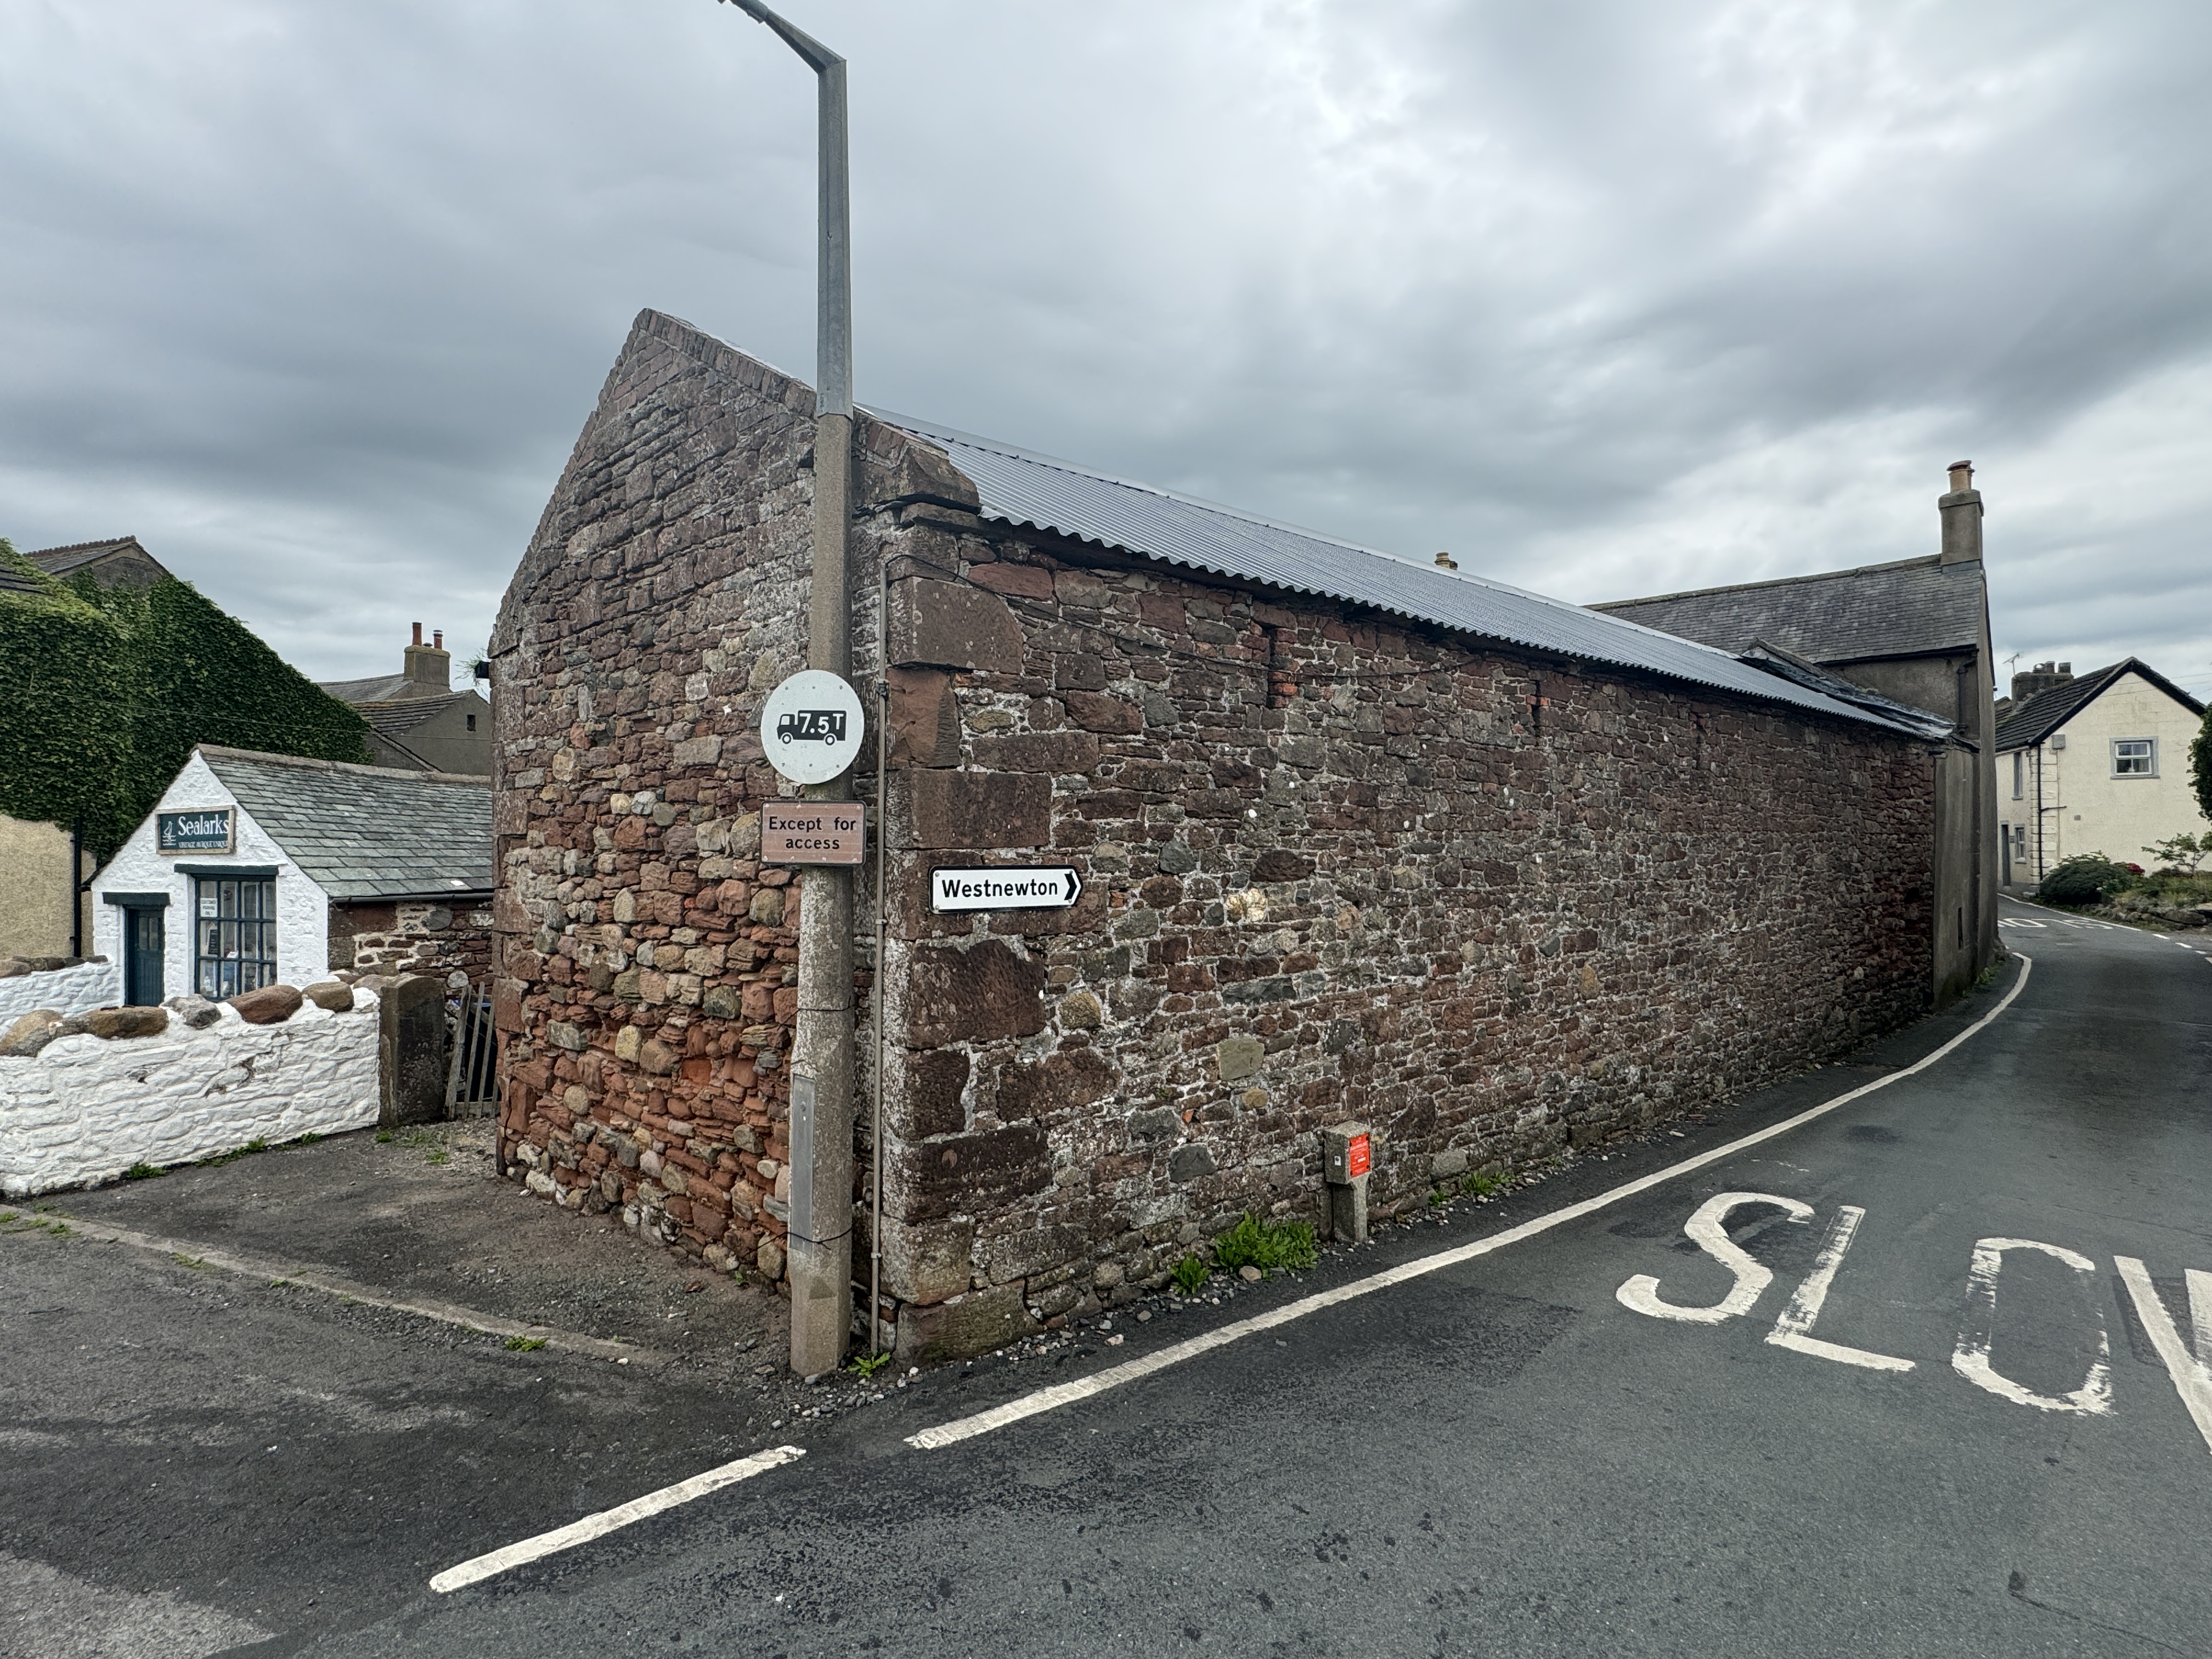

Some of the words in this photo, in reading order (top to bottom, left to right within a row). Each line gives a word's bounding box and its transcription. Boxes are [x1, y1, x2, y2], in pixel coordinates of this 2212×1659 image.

[799, 713, 844, 735] 7.5T
[178, 814, 229, 836] Sealarks
[769, 816, 822, 833] Except
[834, 816, 857, 831] for
[785, 838, 840, 850] access
[941, 878, 1058, 898] Westnewton
